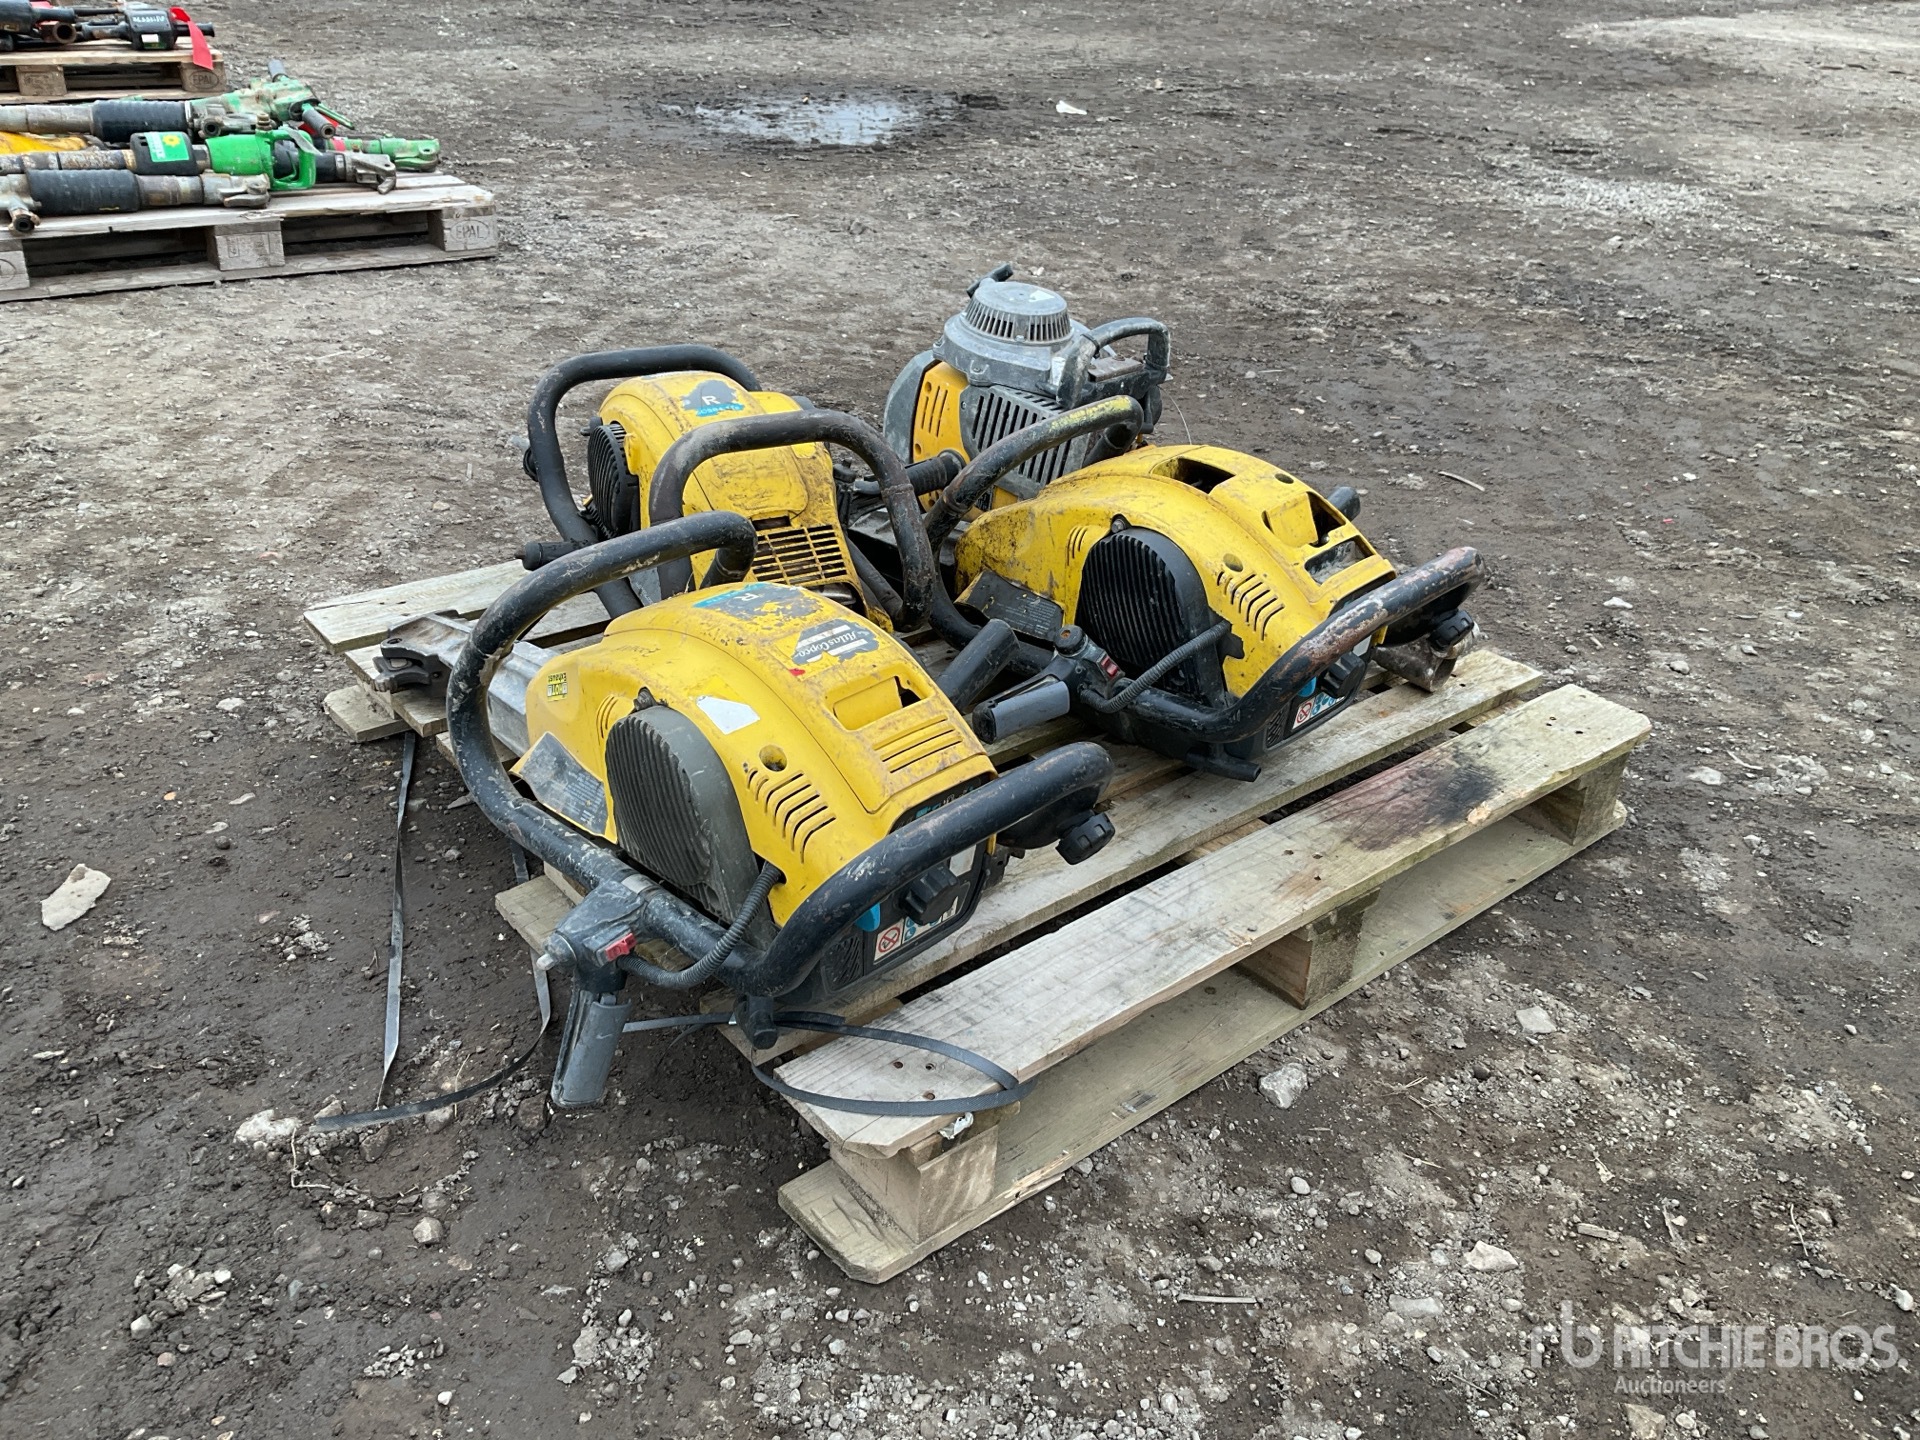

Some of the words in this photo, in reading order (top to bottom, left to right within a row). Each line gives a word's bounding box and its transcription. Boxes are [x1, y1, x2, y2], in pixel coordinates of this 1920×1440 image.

[455, 225, 485, 239] EPAL
[702, 396, 721, 405] R
[828, 631, 857, 646] Atlas
[799, 641, 830, 657] Copco
